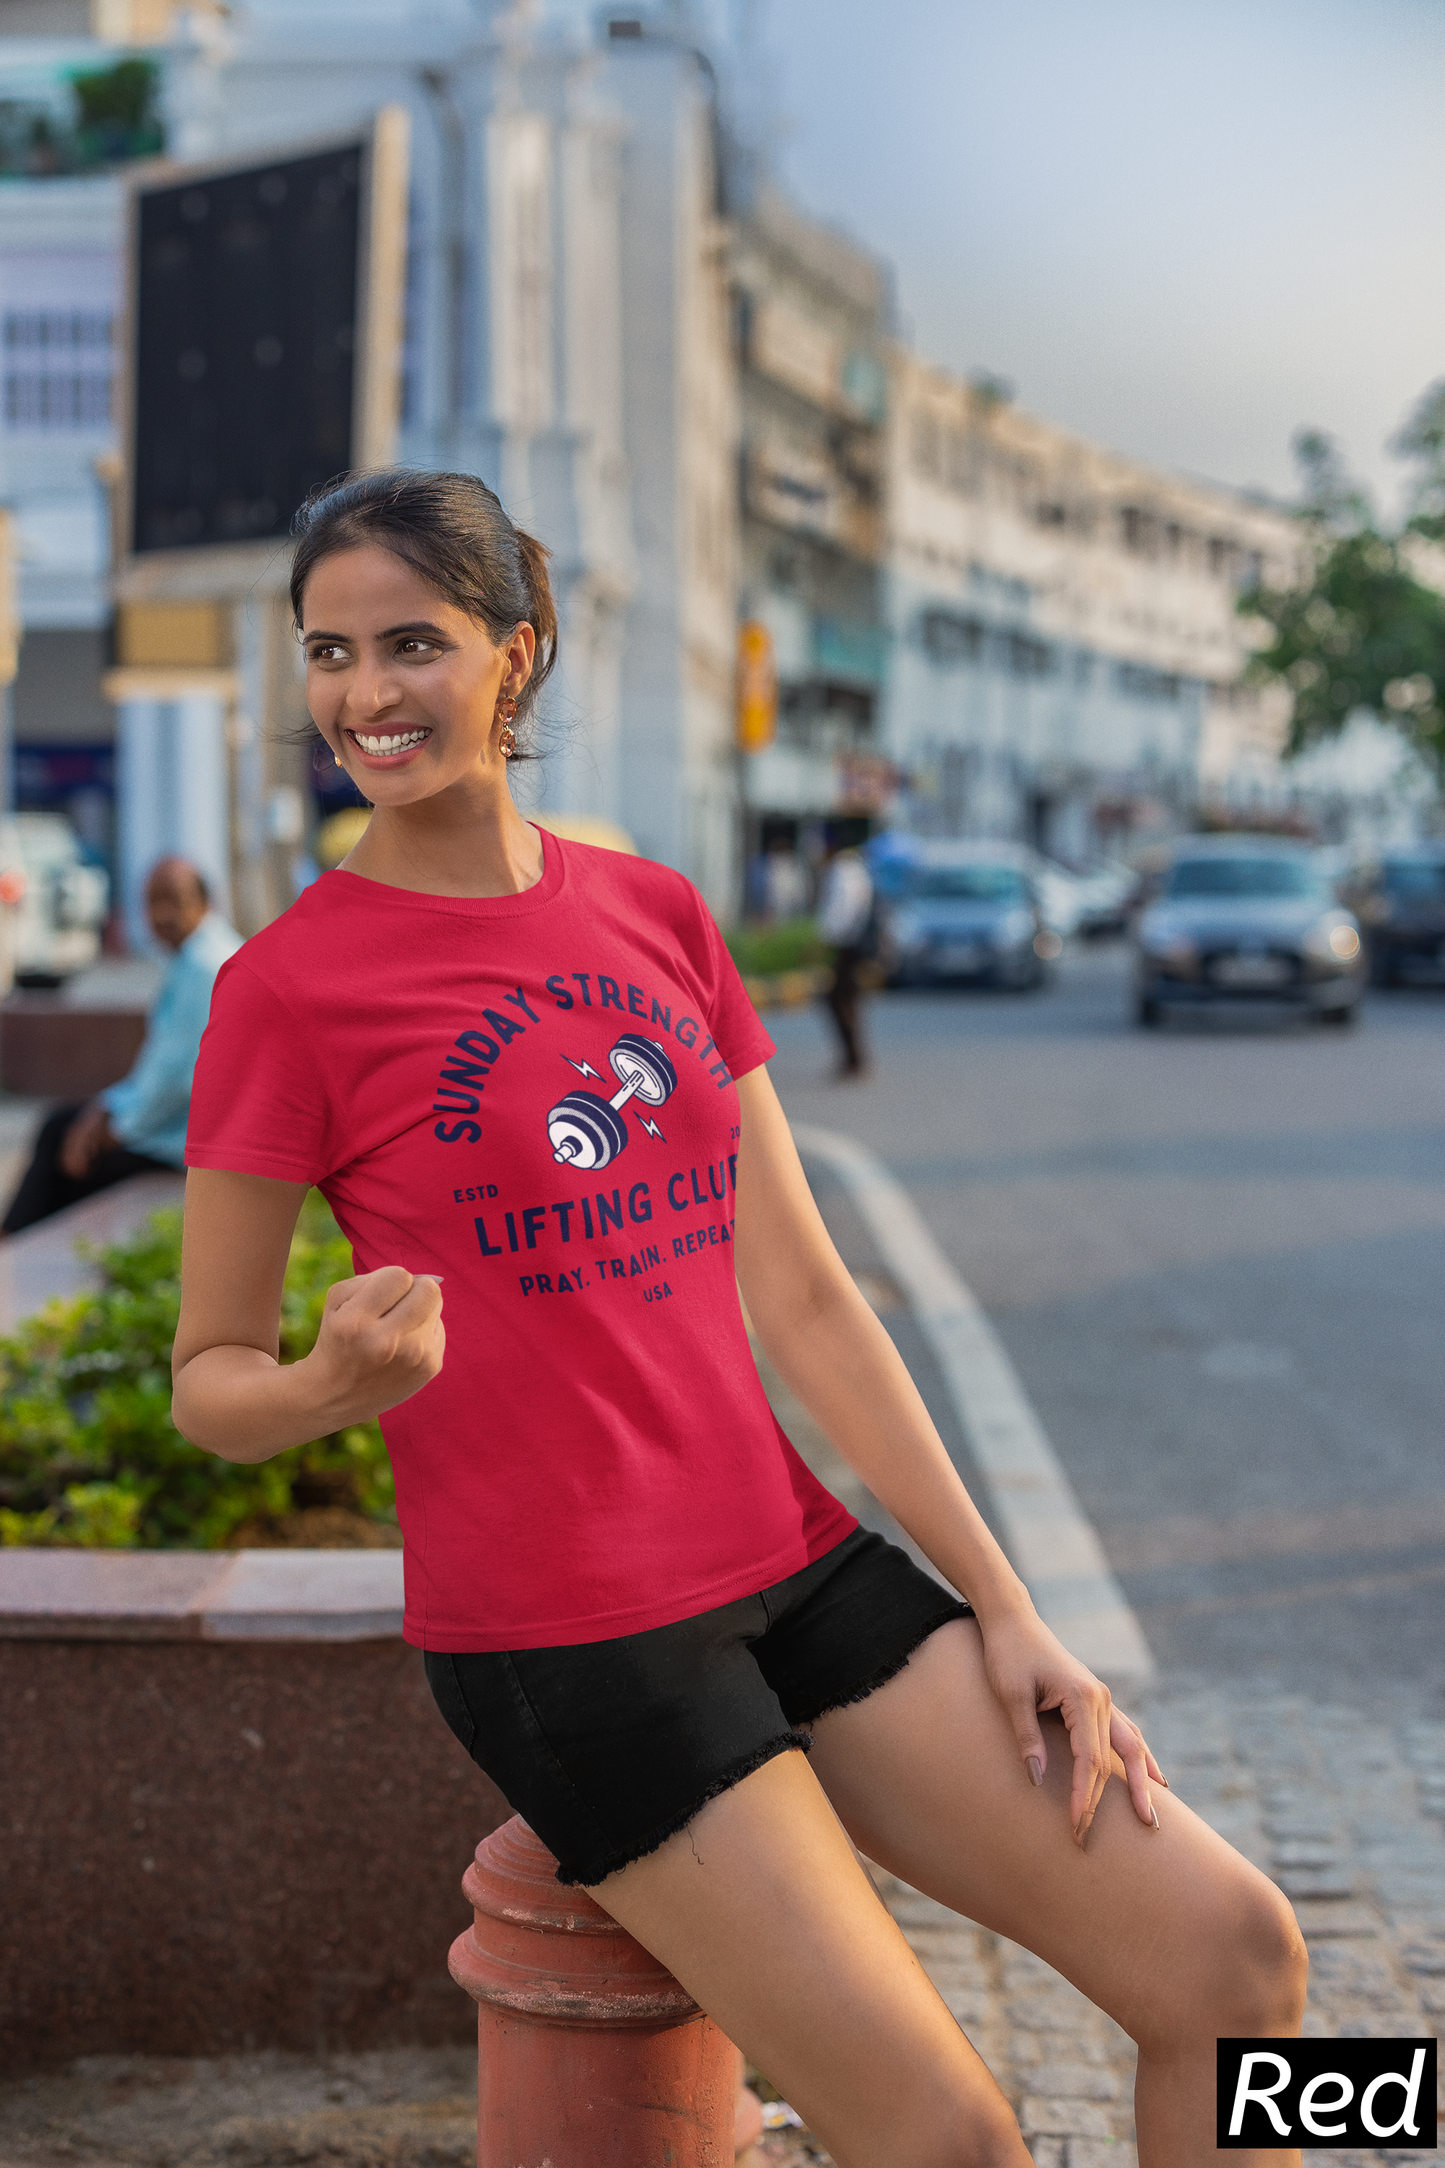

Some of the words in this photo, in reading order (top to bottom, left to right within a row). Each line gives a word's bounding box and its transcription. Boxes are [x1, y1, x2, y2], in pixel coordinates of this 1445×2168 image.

[433, 986, 541, 1144] SUNDAY
[545, 972, 734, 1090] STRENGTH
[453, 1184, 498, 1203] ESTD
[474, 1182, 653, 1257] LIFTING
[519, 1267, 590, 1297] PRAY.
[595, 1245, 667, 1280] TRAIN.
[643, 1281, 673, 1303] USA
